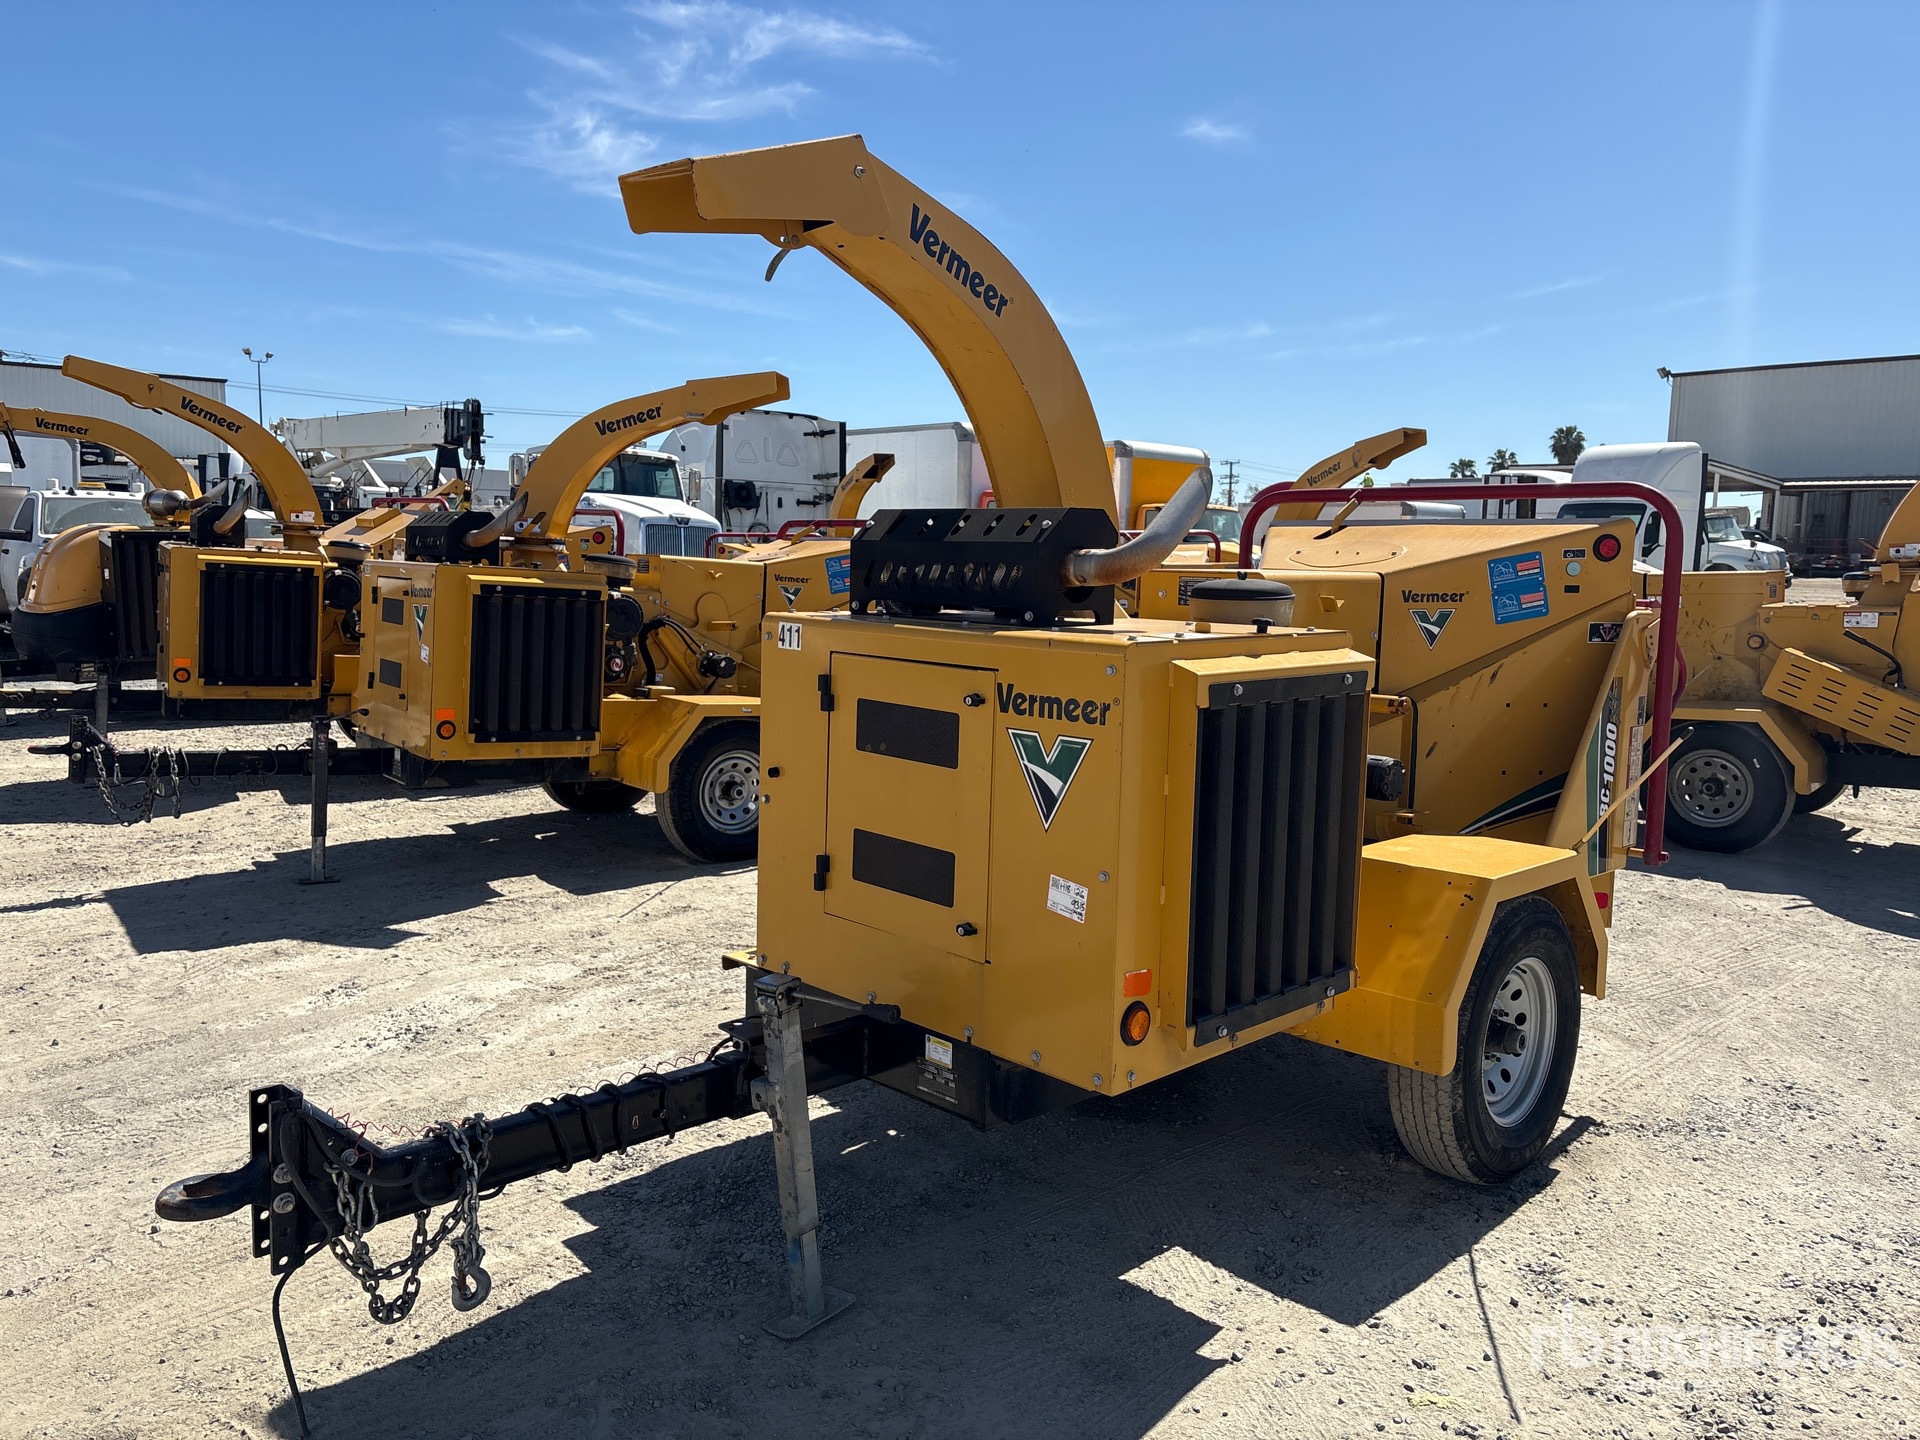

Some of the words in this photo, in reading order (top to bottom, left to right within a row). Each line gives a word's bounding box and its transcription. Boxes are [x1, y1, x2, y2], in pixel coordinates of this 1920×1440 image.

[909, 203, 1009, 318] Vermeer
[35, 417, 89, 436] Vermeer
[181, 396, 243, 434] Vermeer
[595, 405, 662, 436] Vermeer
[1307, 462, 1342, 487] Vermeer
[411, 584, 433, 598] Vermeer
[774, 574, 810, 584] Vermeer
[1401, 589, 1465, 603] Vermeer
[778, 624, 801, 649] 411
[997, 682, 1111, 726] Vermeer
